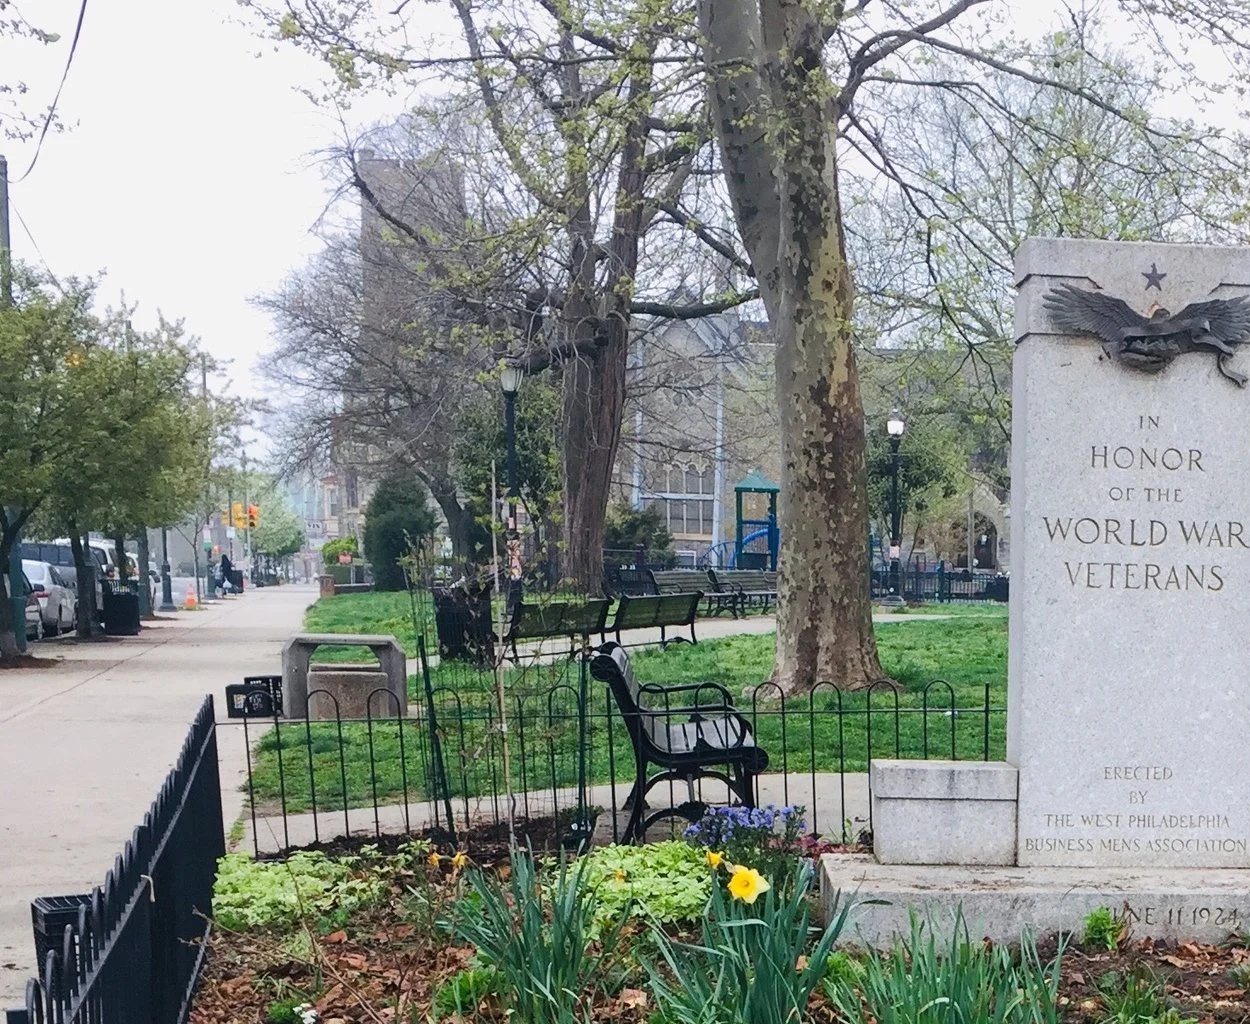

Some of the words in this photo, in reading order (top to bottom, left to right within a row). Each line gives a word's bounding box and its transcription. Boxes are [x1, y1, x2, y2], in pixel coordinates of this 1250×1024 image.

[1139, 415, 1160, 430] IN
[1090, 445, 1206, 473] HONOR
[1108, 486, 1135, 502] OF
[1143, 487, 1184, 503] THE
[1042, 516, 1168, 547] WORLD
[1177, 519, 1250, 549] WAR
[1064, 561, 1226, 592] VETERANS
[1103, 765, 1173, 781] ERECTED
[1128, 790, 1149, 805] BY
[1044, 813, 1075, 828] THE
[1080, 813, 1123, 828] WEST
[1128, 813, 1230, 830] PHILADELPHIA
[1025, 837, 1094, 853] BUSINESS
[1146, 837, 1247, 854] ASSOCIATION
[1106, 907, 1158, 926] UNE
